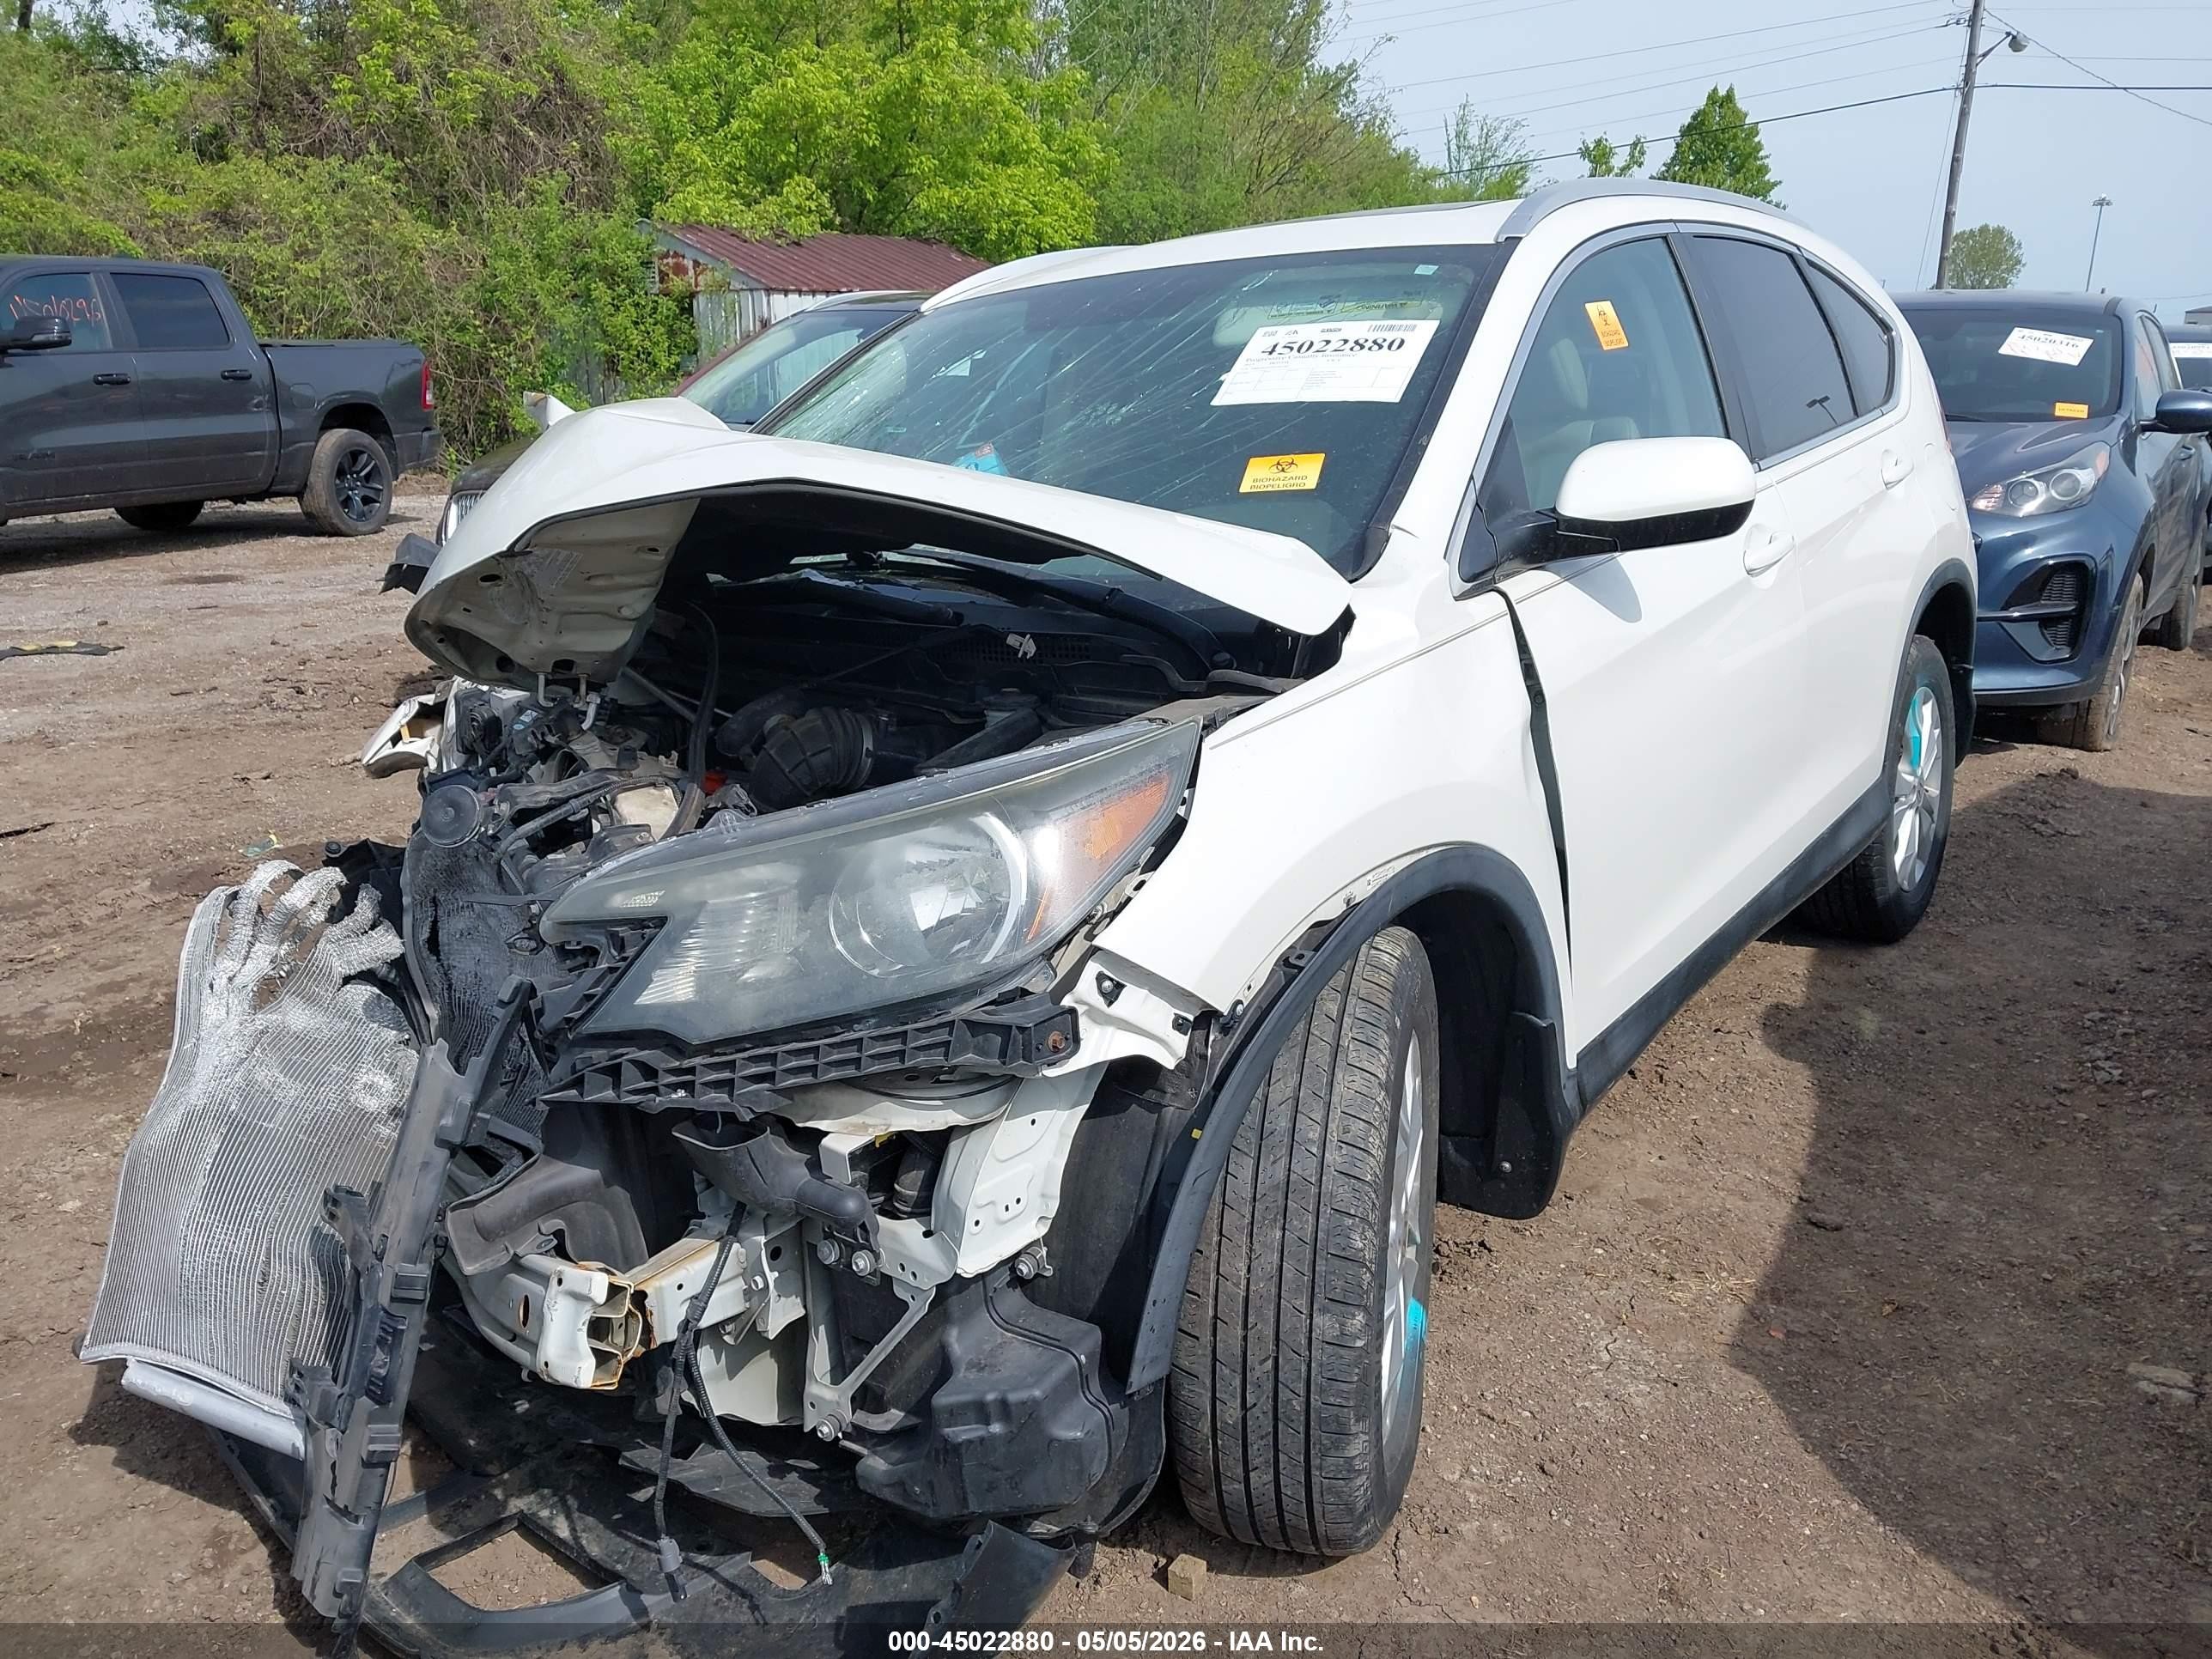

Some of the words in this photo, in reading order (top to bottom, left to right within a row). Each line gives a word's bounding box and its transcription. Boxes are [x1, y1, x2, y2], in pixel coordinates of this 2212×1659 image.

[1261, 337, 1406, 356] 45022880
[1252, 475, 1308, 483] BIOHAZARD
[1249, 482, 1306, 490] BIOPELIGRO
